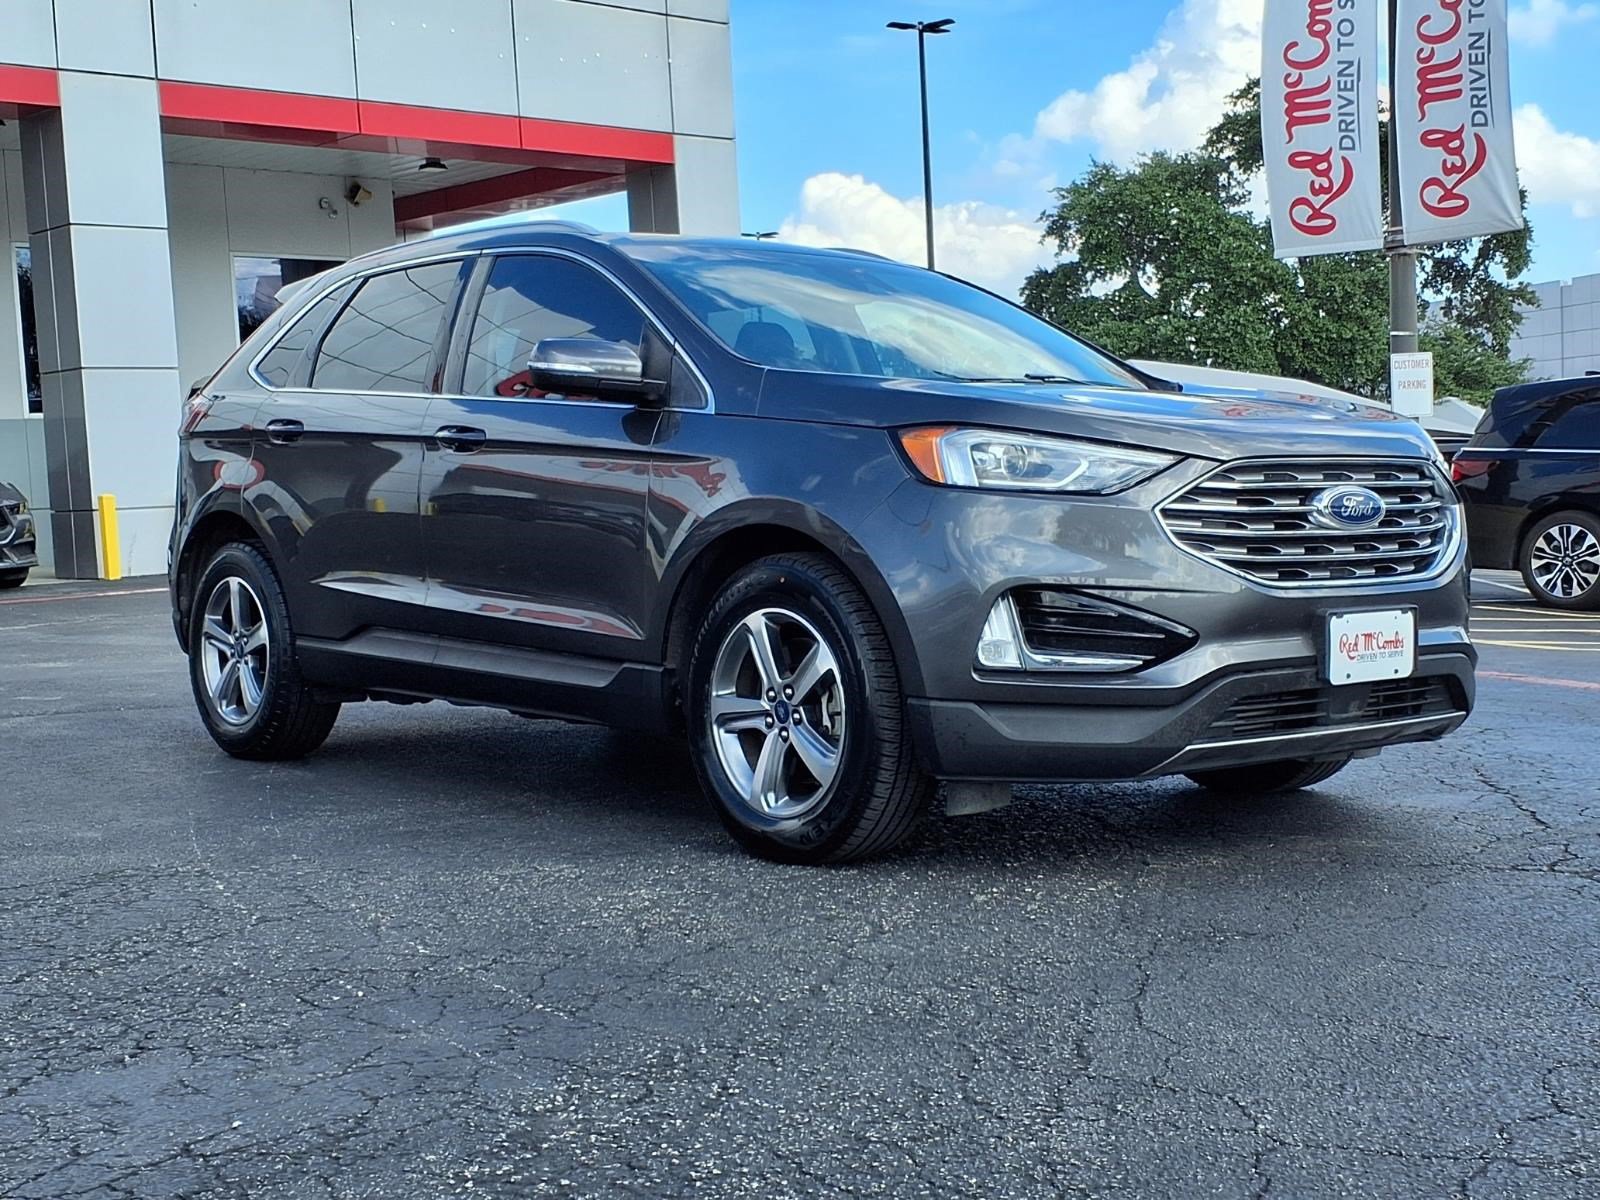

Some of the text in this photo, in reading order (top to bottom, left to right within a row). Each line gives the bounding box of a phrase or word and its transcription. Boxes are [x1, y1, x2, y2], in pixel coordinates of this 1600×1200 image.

[1337, 18, 1355, 52] TO
[1468, 31, 1488, 128] DRIVEN
[1337, 60, 1355, 151] DRIVEN
[1419, 123, 1487, 218] Red
[1288, 147, 1354, 236] Red
[1393, 359, 1430, 370] CUSTOMER
[1398, 379, 1427, 390] PARKING
[1341, 495, 1374, 517] Ford
[1339, 630, 1404, 660] Red McCombs
[1356, 649, 1404, 661] DRIVEN TO SERVE
